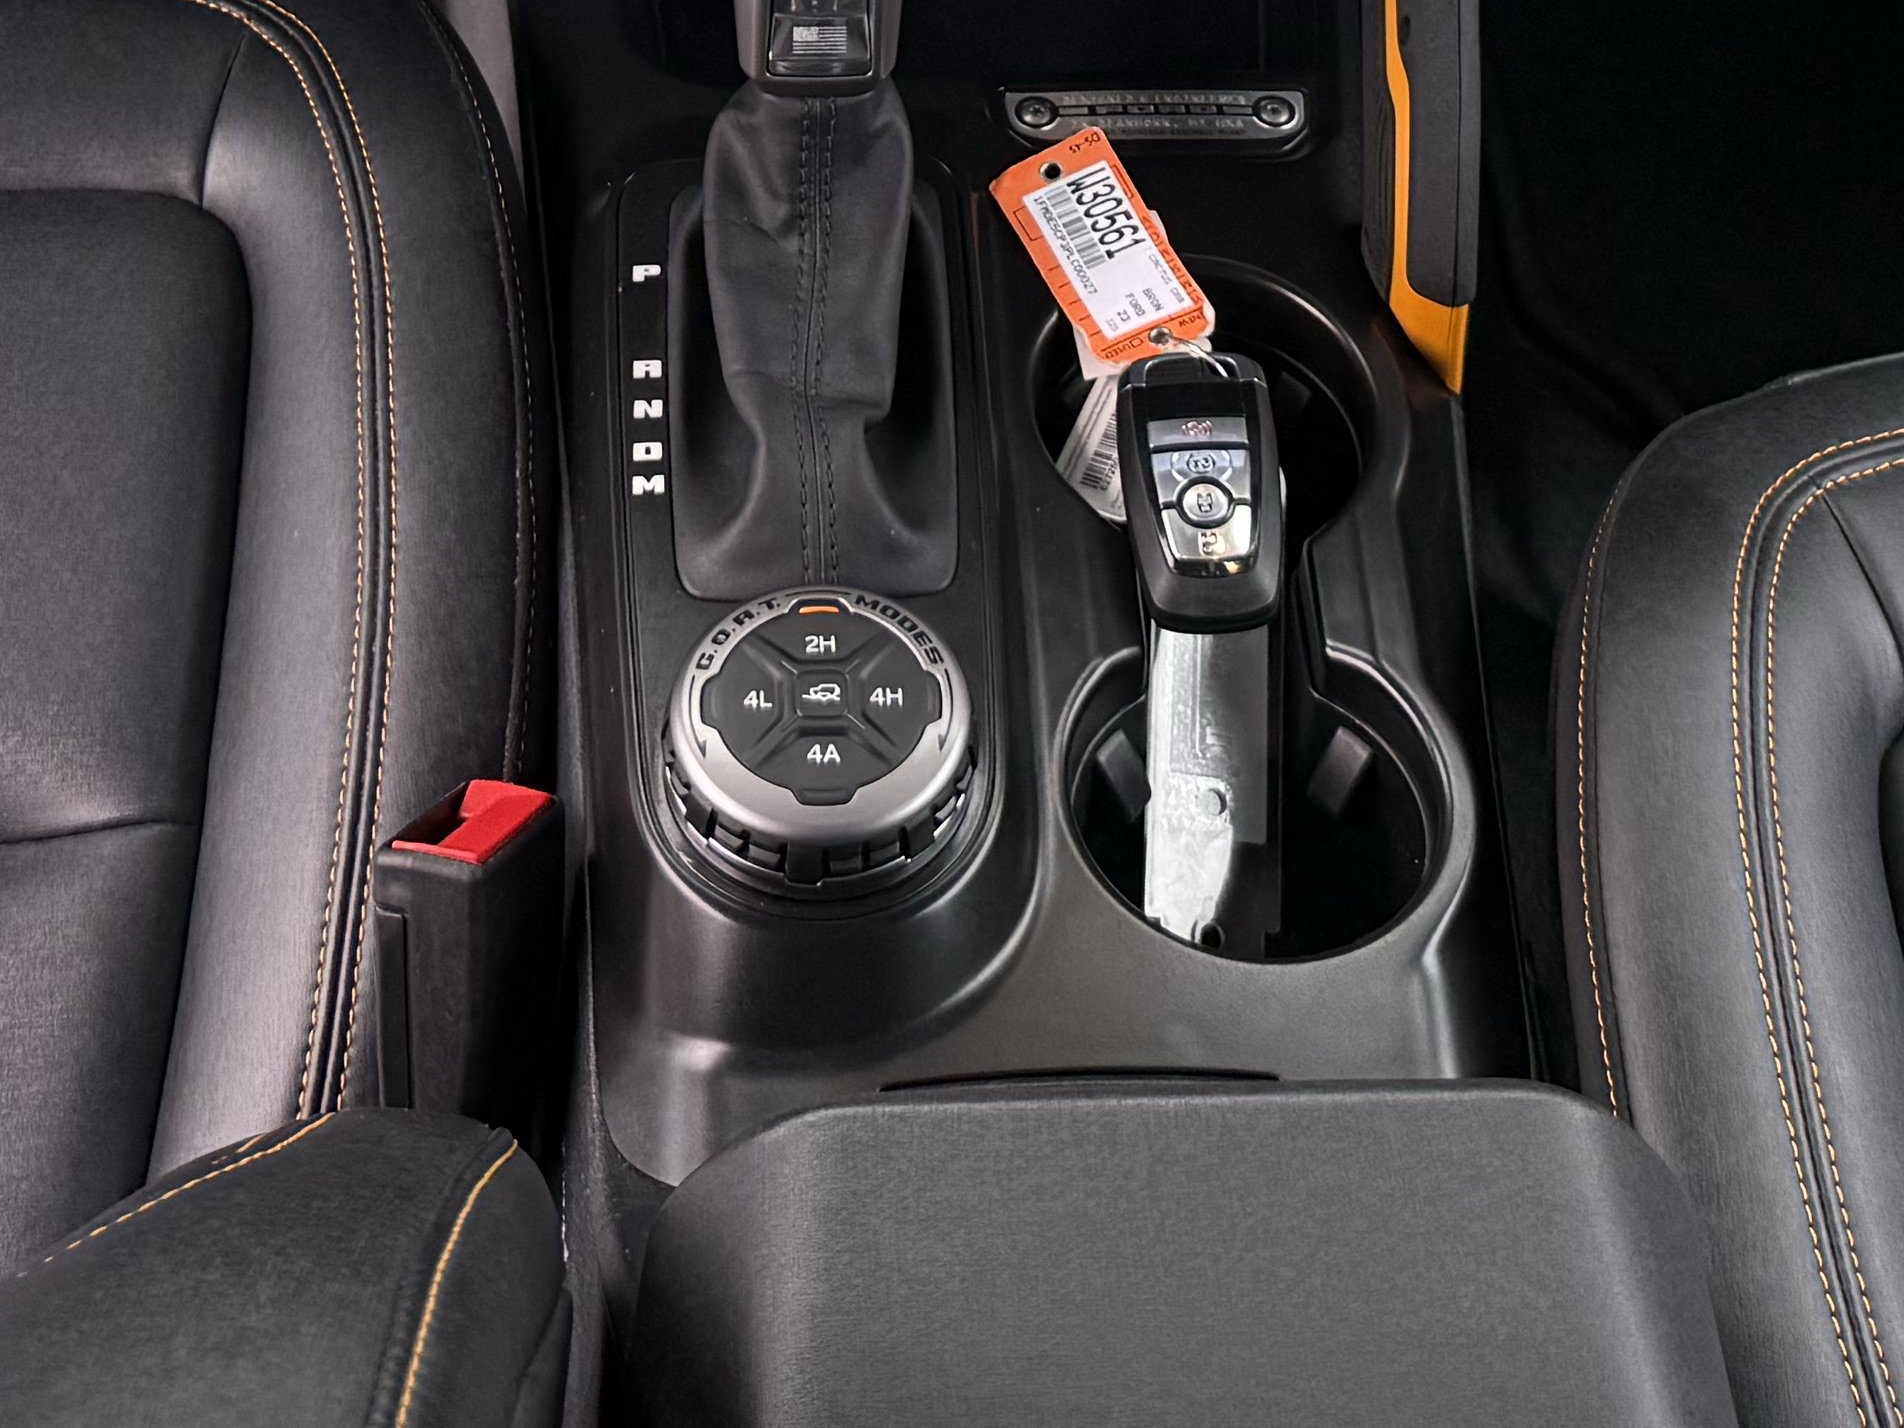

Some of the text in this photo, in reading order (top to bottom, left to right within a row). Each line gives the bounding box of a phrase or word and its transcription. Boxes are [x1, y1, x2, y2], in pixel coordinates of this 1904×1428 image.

[1067, 167, 1145, 259] W30561
[632, 264, 661, 282] P
[1126, 293, 1145, 316] FORD
[1143, 288, 1164, 311] BRON
[633, 400, 663, 419] N
[632, 475, 665, 495] M
[855, 595, 944, 665] MODES
[805, 635, 836, 653] 2H
[743, 691, 773, 709] 4L
[870, 687, 903, 707] 4H
[807, 744, 841, 763] 4A
